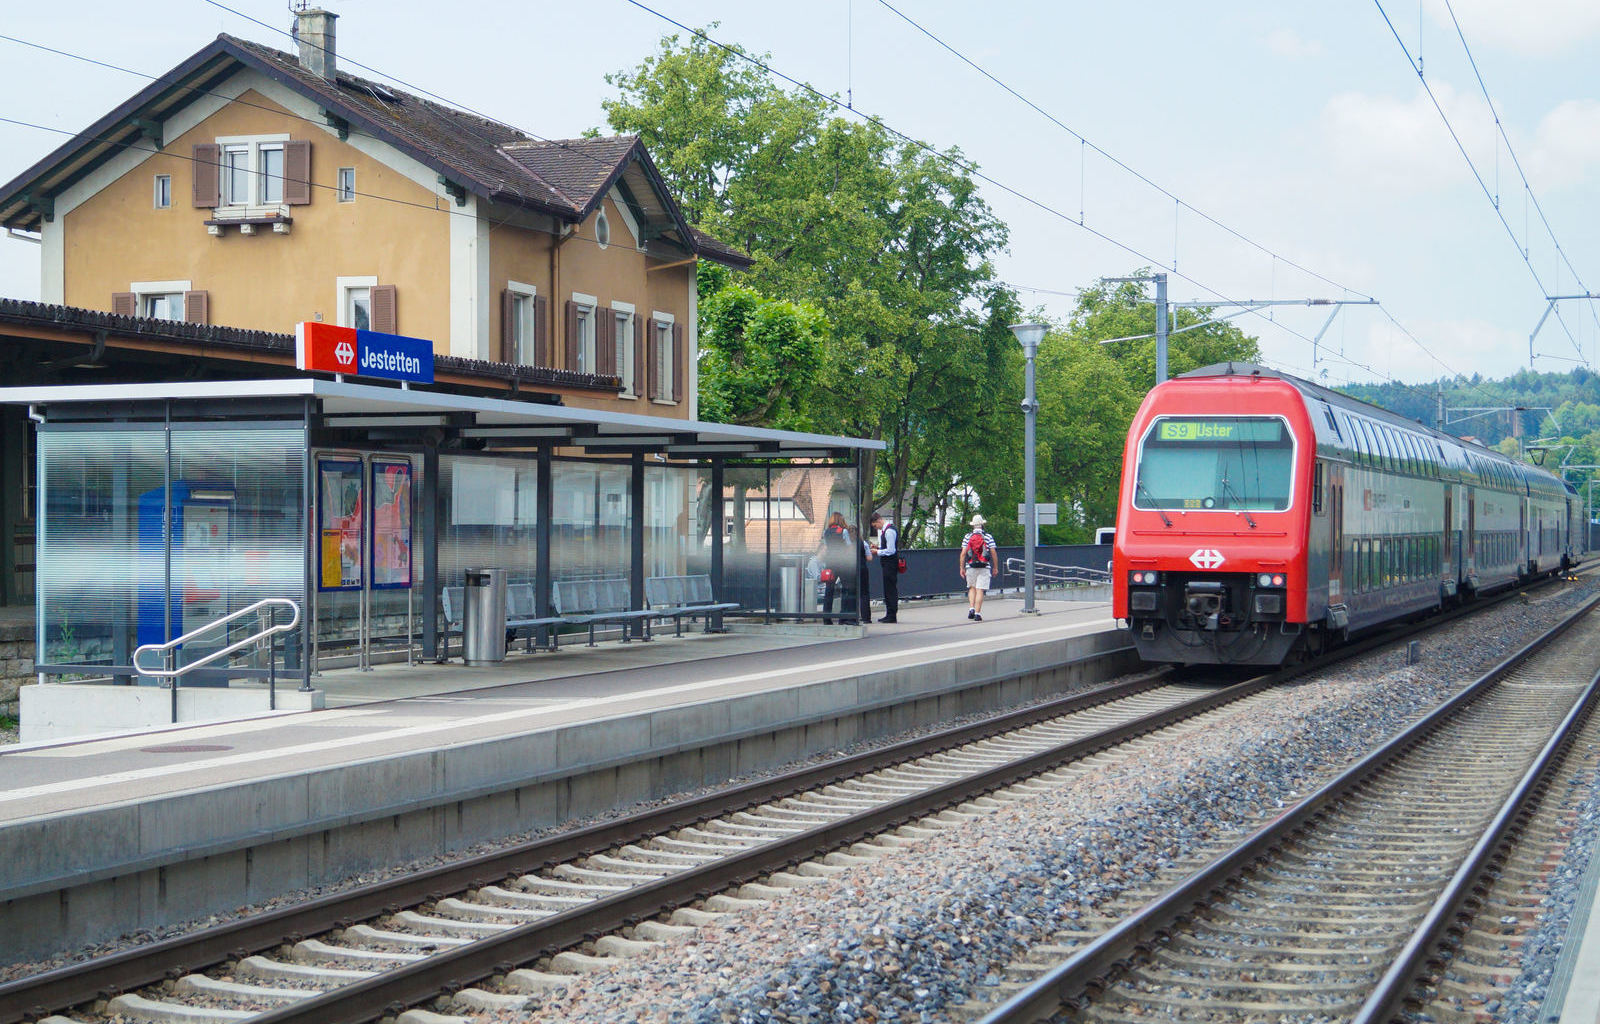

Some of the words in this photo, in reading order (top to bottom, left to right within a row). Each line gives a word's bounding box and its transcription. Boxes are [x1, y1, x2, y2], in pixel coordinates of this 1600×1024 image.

[361, 346, 421, 374] Jestetten
[1167, 424, 1189, 438] S9
[1197, 423, 1233, 437] Uster
